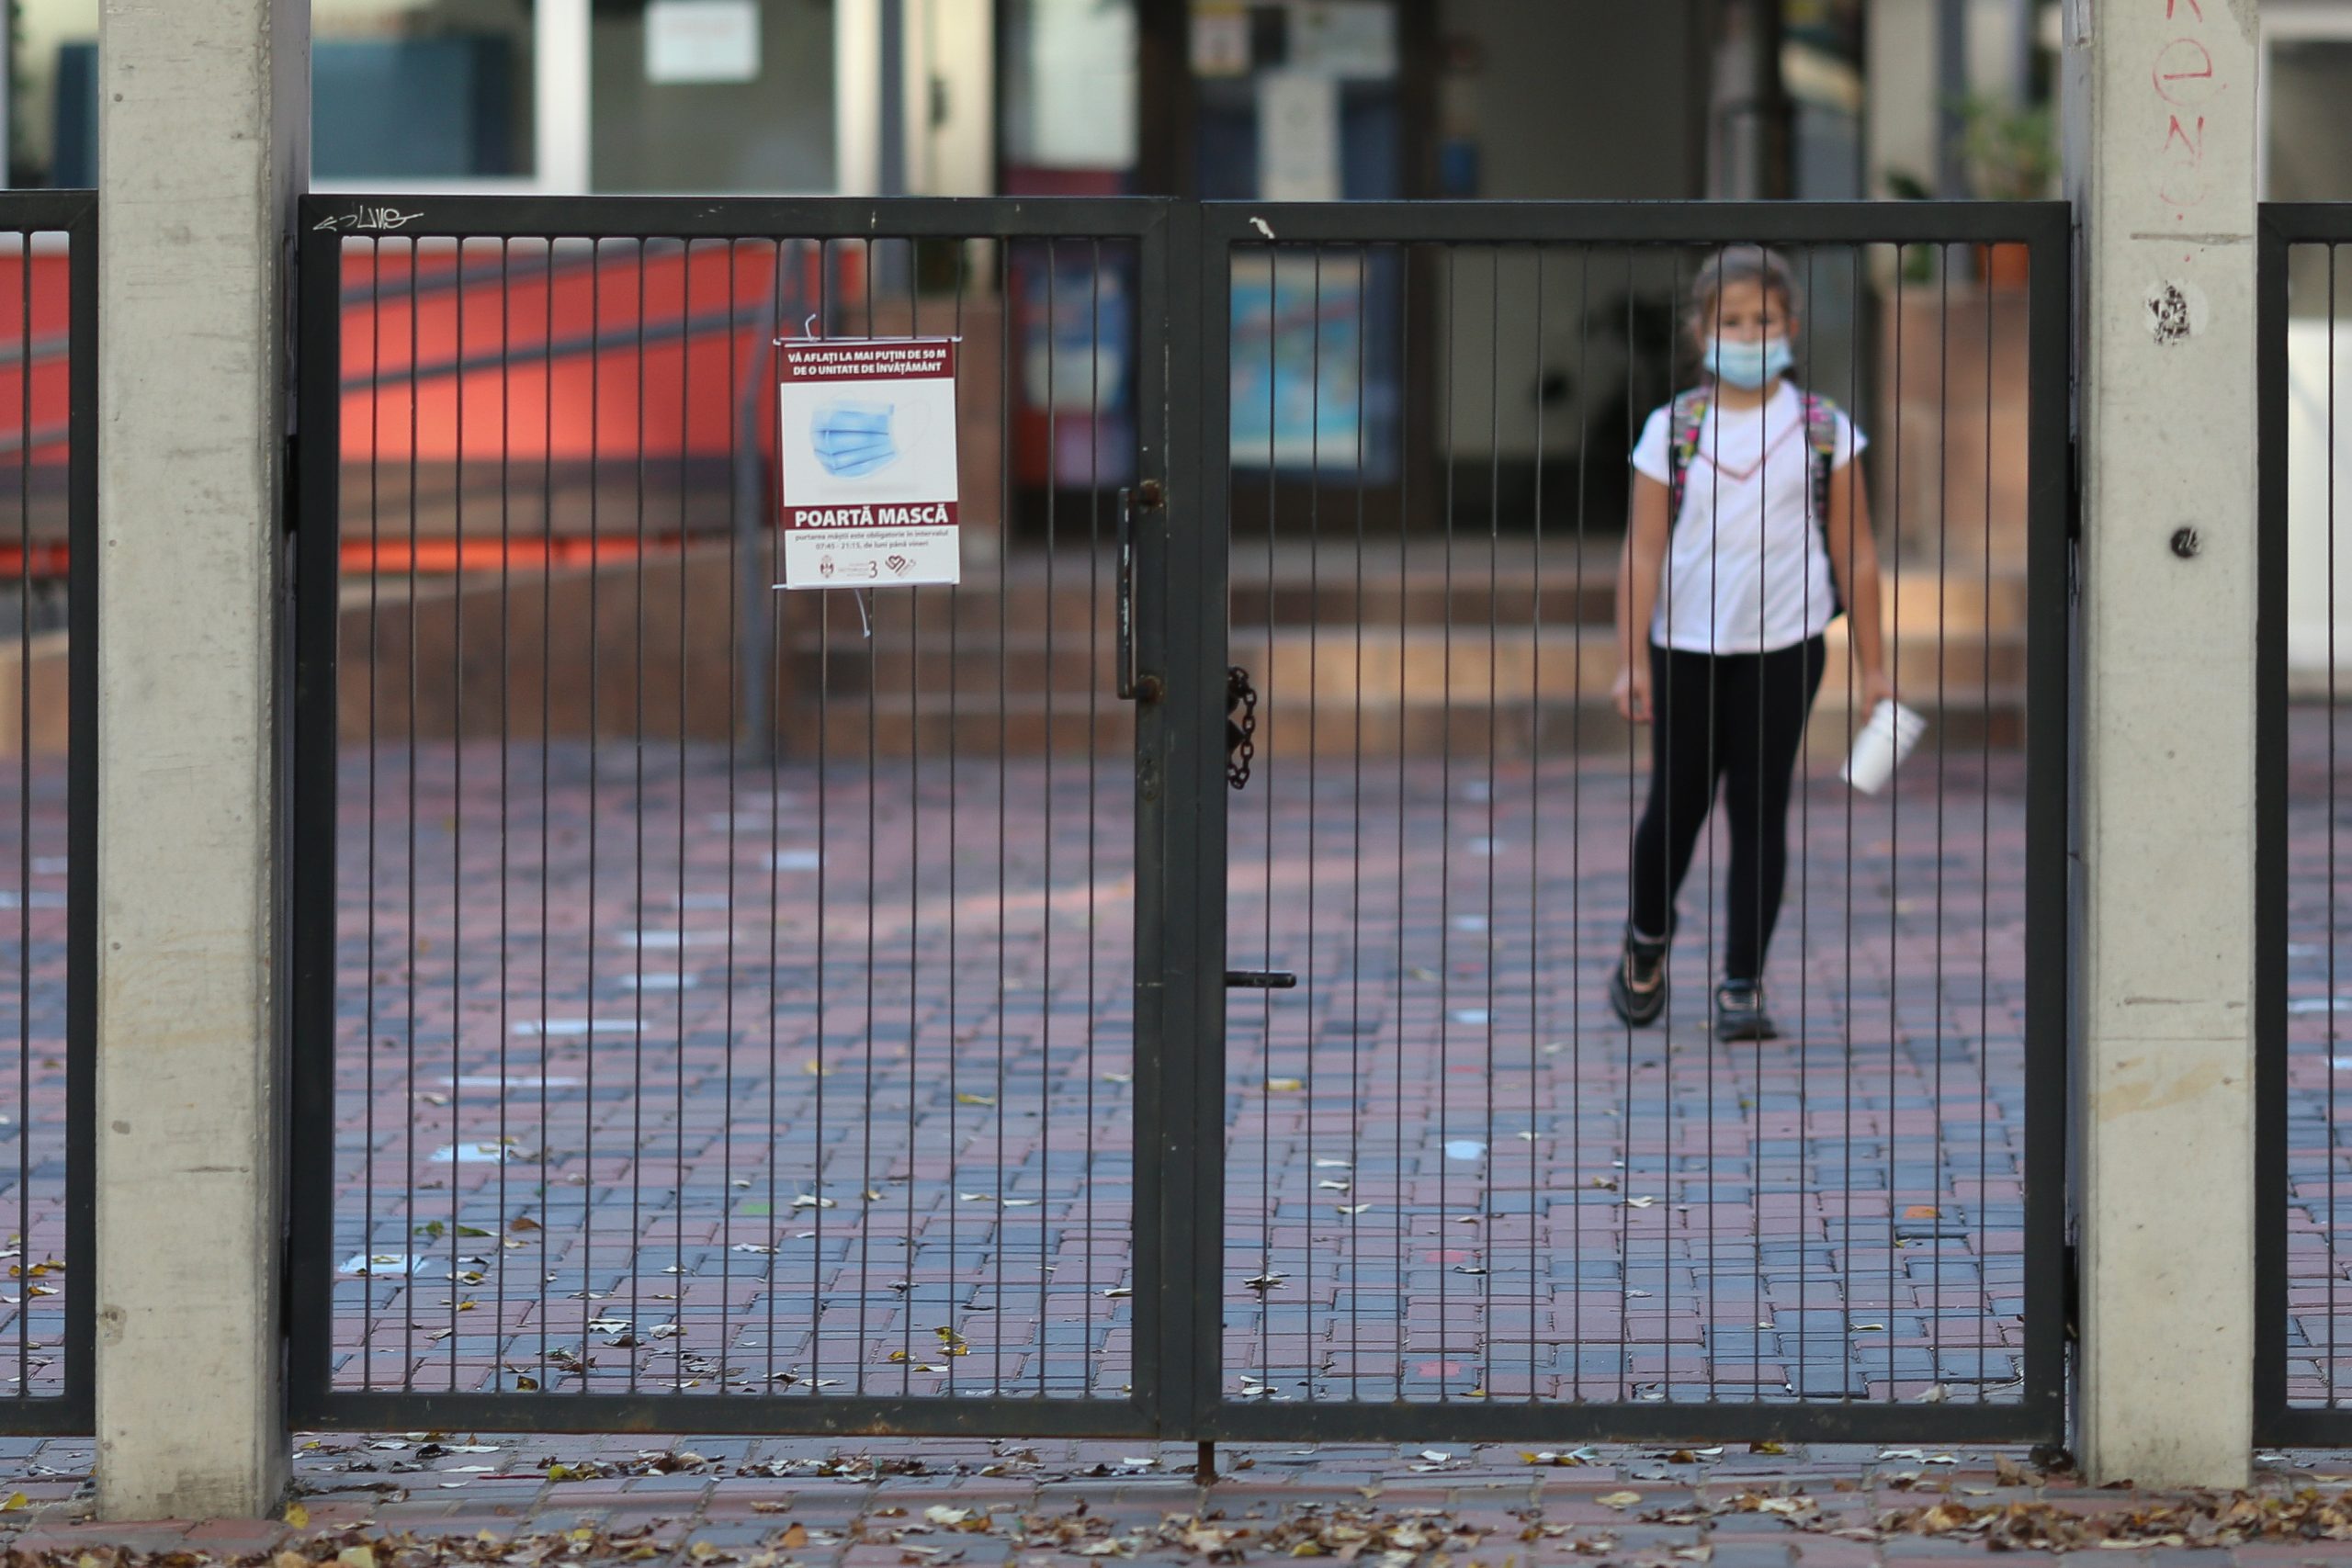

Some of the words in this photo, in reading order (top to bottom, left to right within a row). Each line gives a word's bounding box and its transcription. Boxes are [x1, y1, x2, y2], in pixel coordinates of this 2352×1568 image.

[840, 351, 853, 362] LA
[854, 350, 873, 361] MAI
[908, 349, 921, 359] DE
[922, 349, 935, 359] 50
[936, 349, 946, 359] M
[793, 366, 807, 376] DE
[808, 366, 817, 375] O
[819, 364, 859, 375] UNITATE
[861, 364, 875, 374] DE
[795, 505, 874, 527] POARTĂ
[878, 503, 948, 525] MASCĂ
[868, 560, 878, 579] 3
